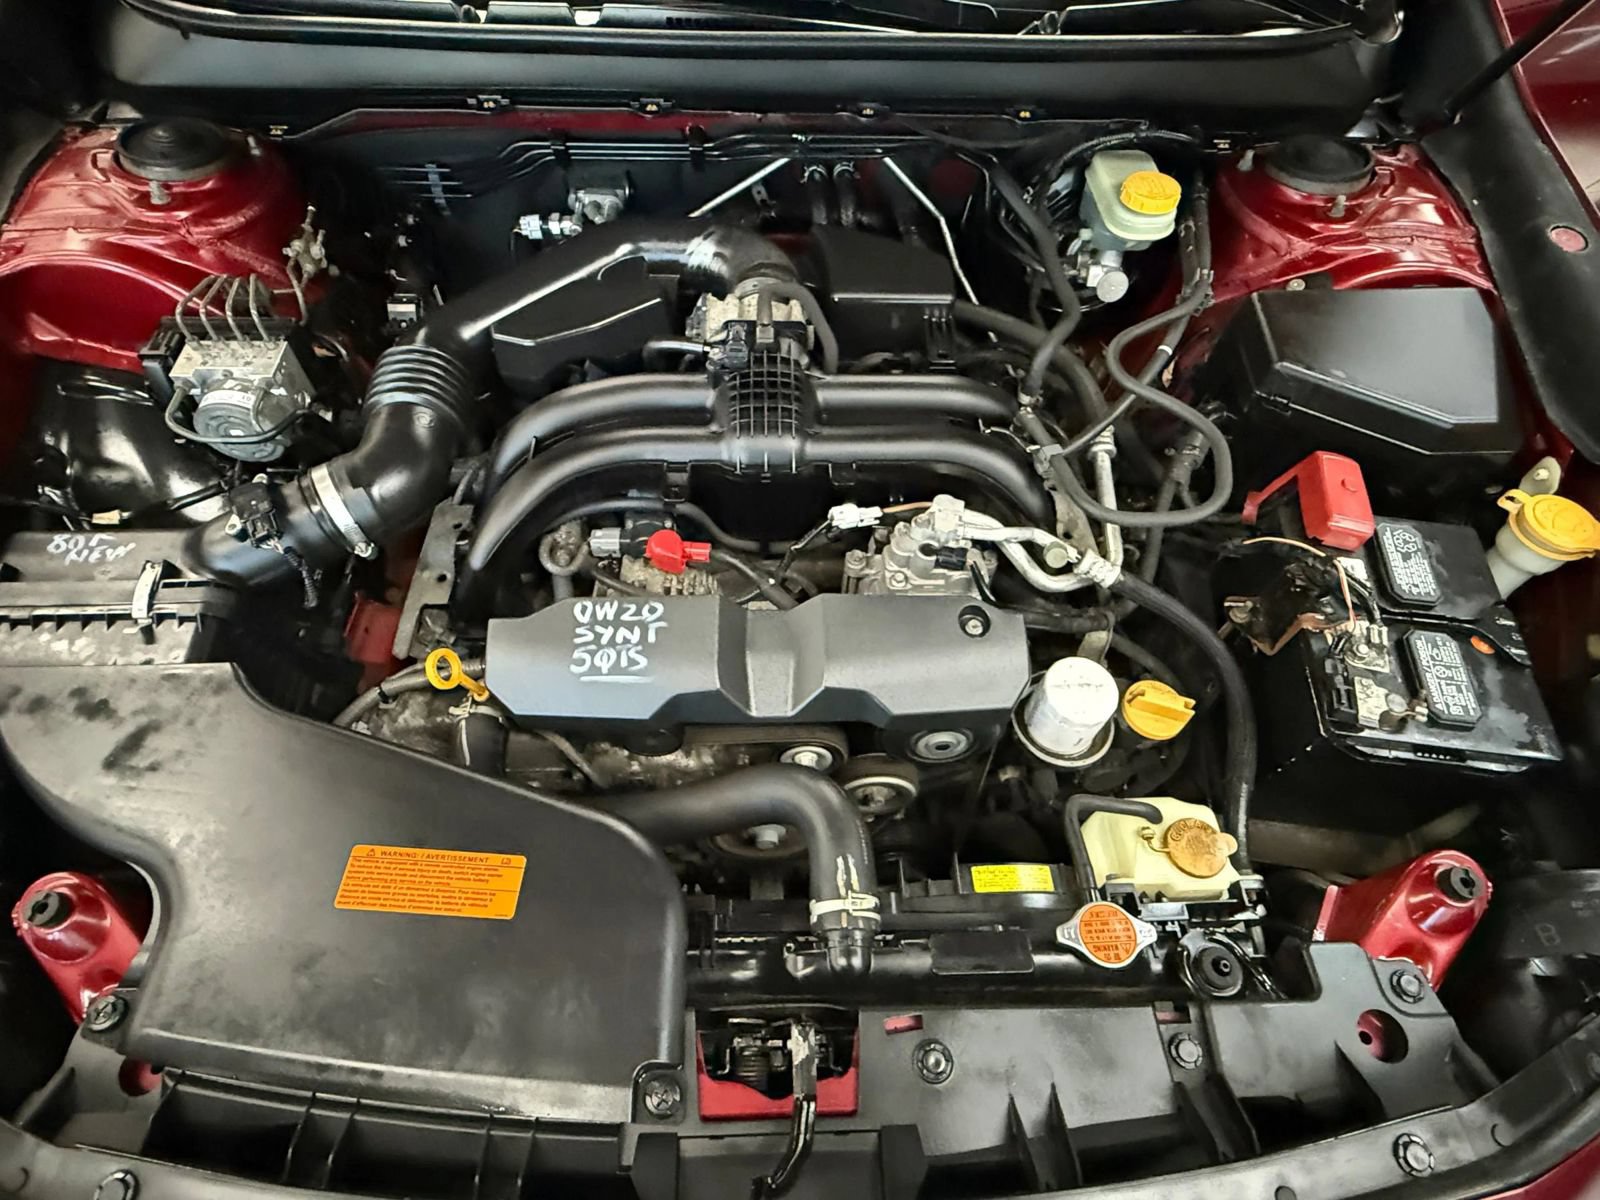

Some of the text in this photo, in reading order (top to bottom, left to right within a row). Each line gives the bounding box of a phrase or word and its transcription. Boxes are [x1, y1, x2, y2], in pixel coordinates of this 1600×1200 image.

[64, 542, 136, 566] NEW
[573, 621, 669, 645] SYNT
[426, 853, 489, 863] AVERTISSEMENT
